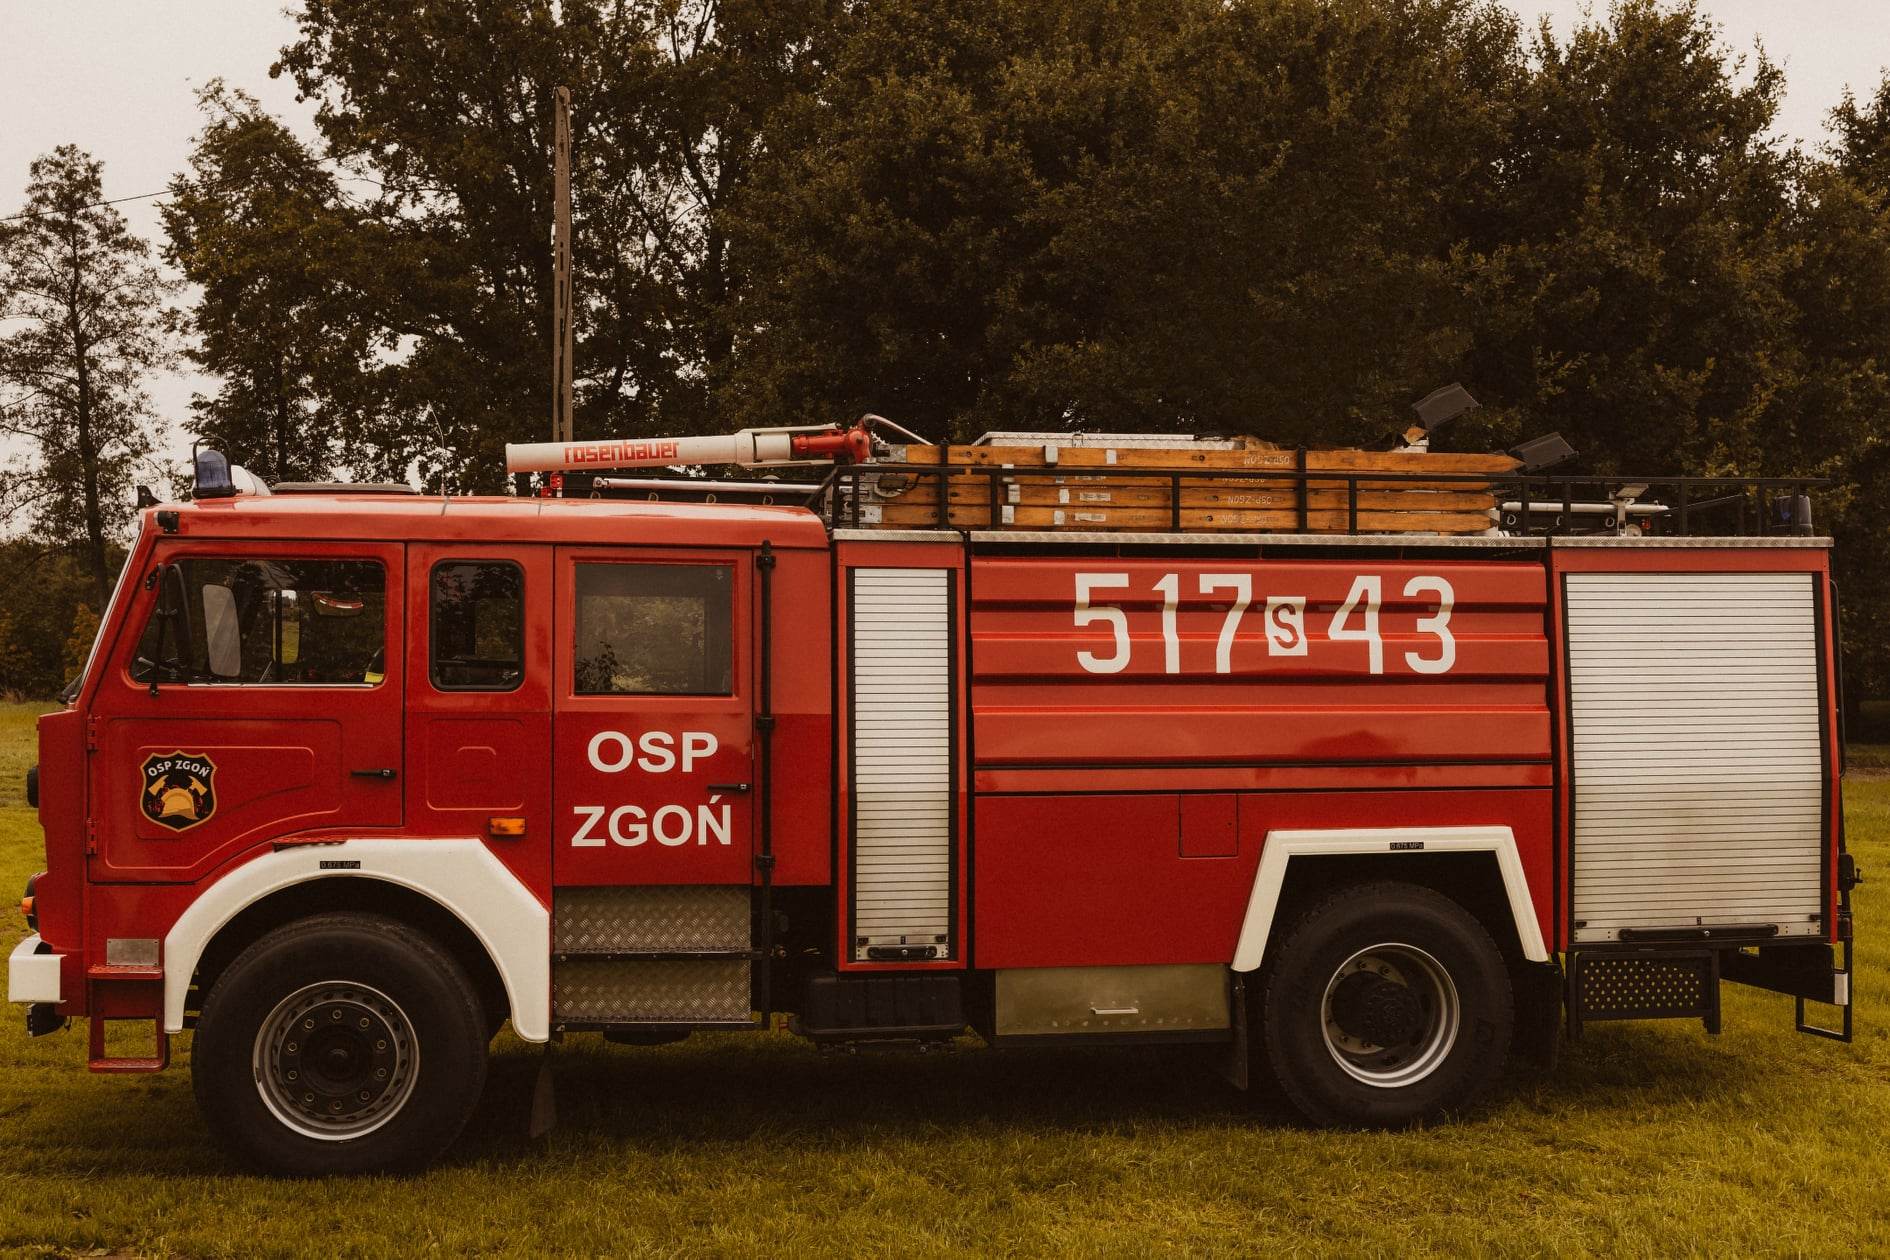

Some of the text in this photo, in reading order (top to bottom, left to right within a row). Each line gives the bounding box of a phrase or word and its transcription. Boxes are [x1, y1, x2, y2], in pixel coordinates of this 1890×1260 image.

[564, 441, 680, 464] rosenbauer
[1074, 573, 1252, 674] 517
[1328, 575, 1456, 674] 43
[148, 760, 211, 777] OSP ZGOŃ
[587, 730, 719, 773] OSP
[571, 794, 732, 847] ZGOŃ
